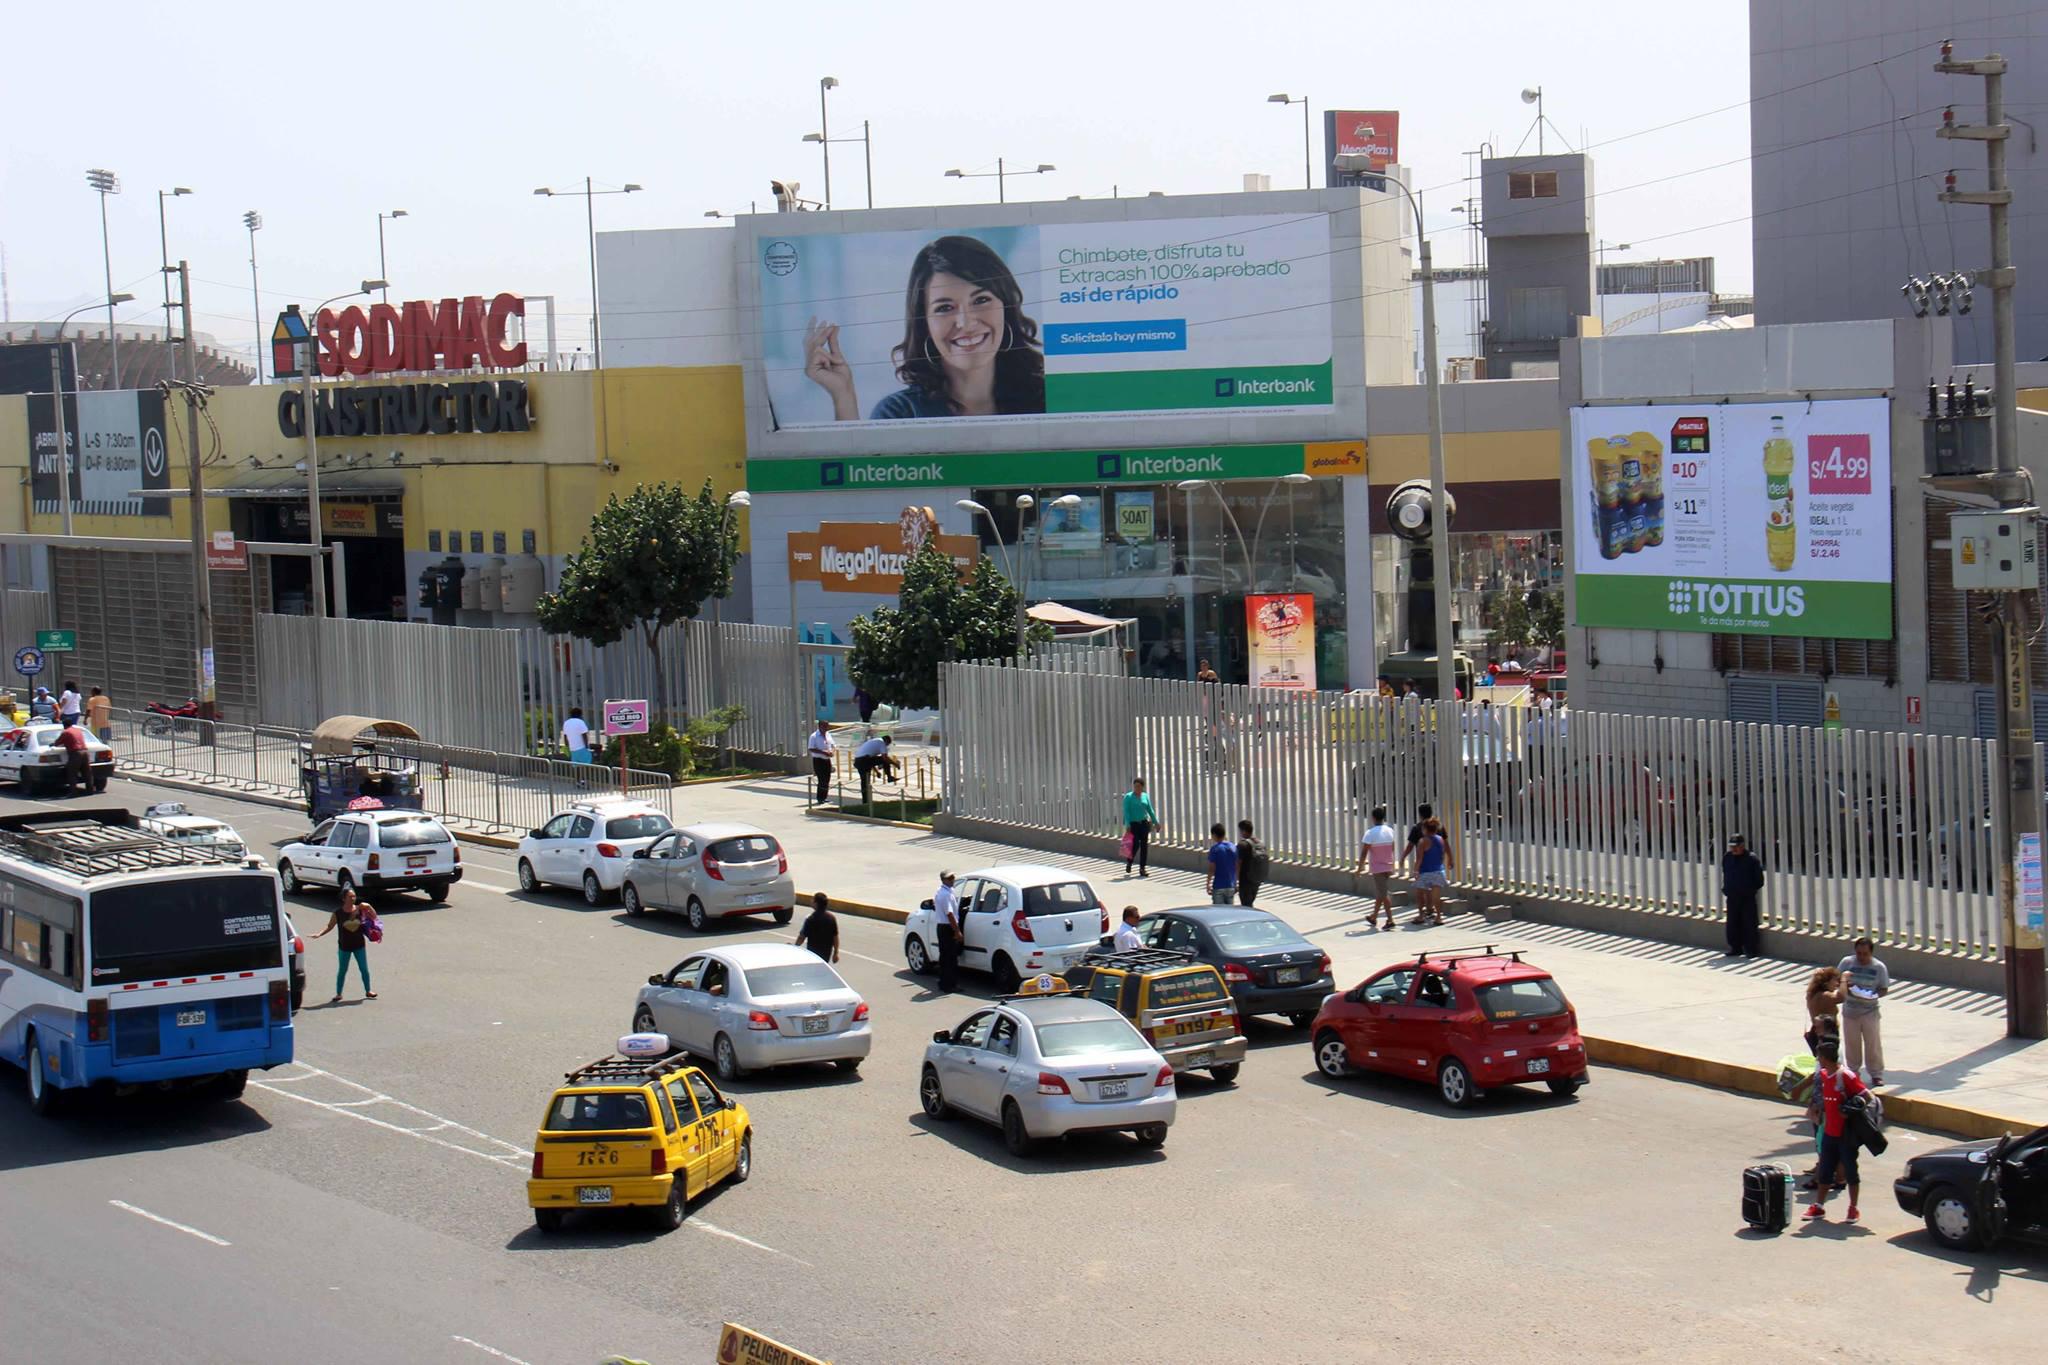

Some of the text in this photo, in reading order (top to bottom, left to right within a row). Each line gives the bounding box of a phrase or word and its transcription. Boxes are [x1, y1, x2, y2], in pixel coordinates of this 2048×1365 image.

[1058, 243, 1245, 265] Chimbote, disfruta tu
[1059, 260, 1291, 284] Extracash 100% aprobado
[1060, 284, 1179, 304] así de rápido
[316, 292, 527, 377] SODIMAC
[1060, 330, 1176, 344] Solicítalo hoy mismo
[1237, 377, 1316, 395] Interbank
[85, 432, 136, 449] L-S 7:30am
[38, 452, 74, 474] ANTS!
[849, 462, 944, 482] Interbank
[1126, 453, 1224, 475] Interbank
[1681, 462, 1697, 478] 10
[1122, 510, 1148, 525] SOAT
[1809, 502, 1854, 514] Aceite vegetal
[1810, 515, 1829, 526] IDEAL
[1693, 583, 1806, 617] TOTTUS
[1701, 616, 1770, 628] Te da más por menos
[1040, 978, 1051, 989] 25
[1176, 1014, 1215, 1035] 0197
[741, 1335, 789, 1365] PELIGRO
